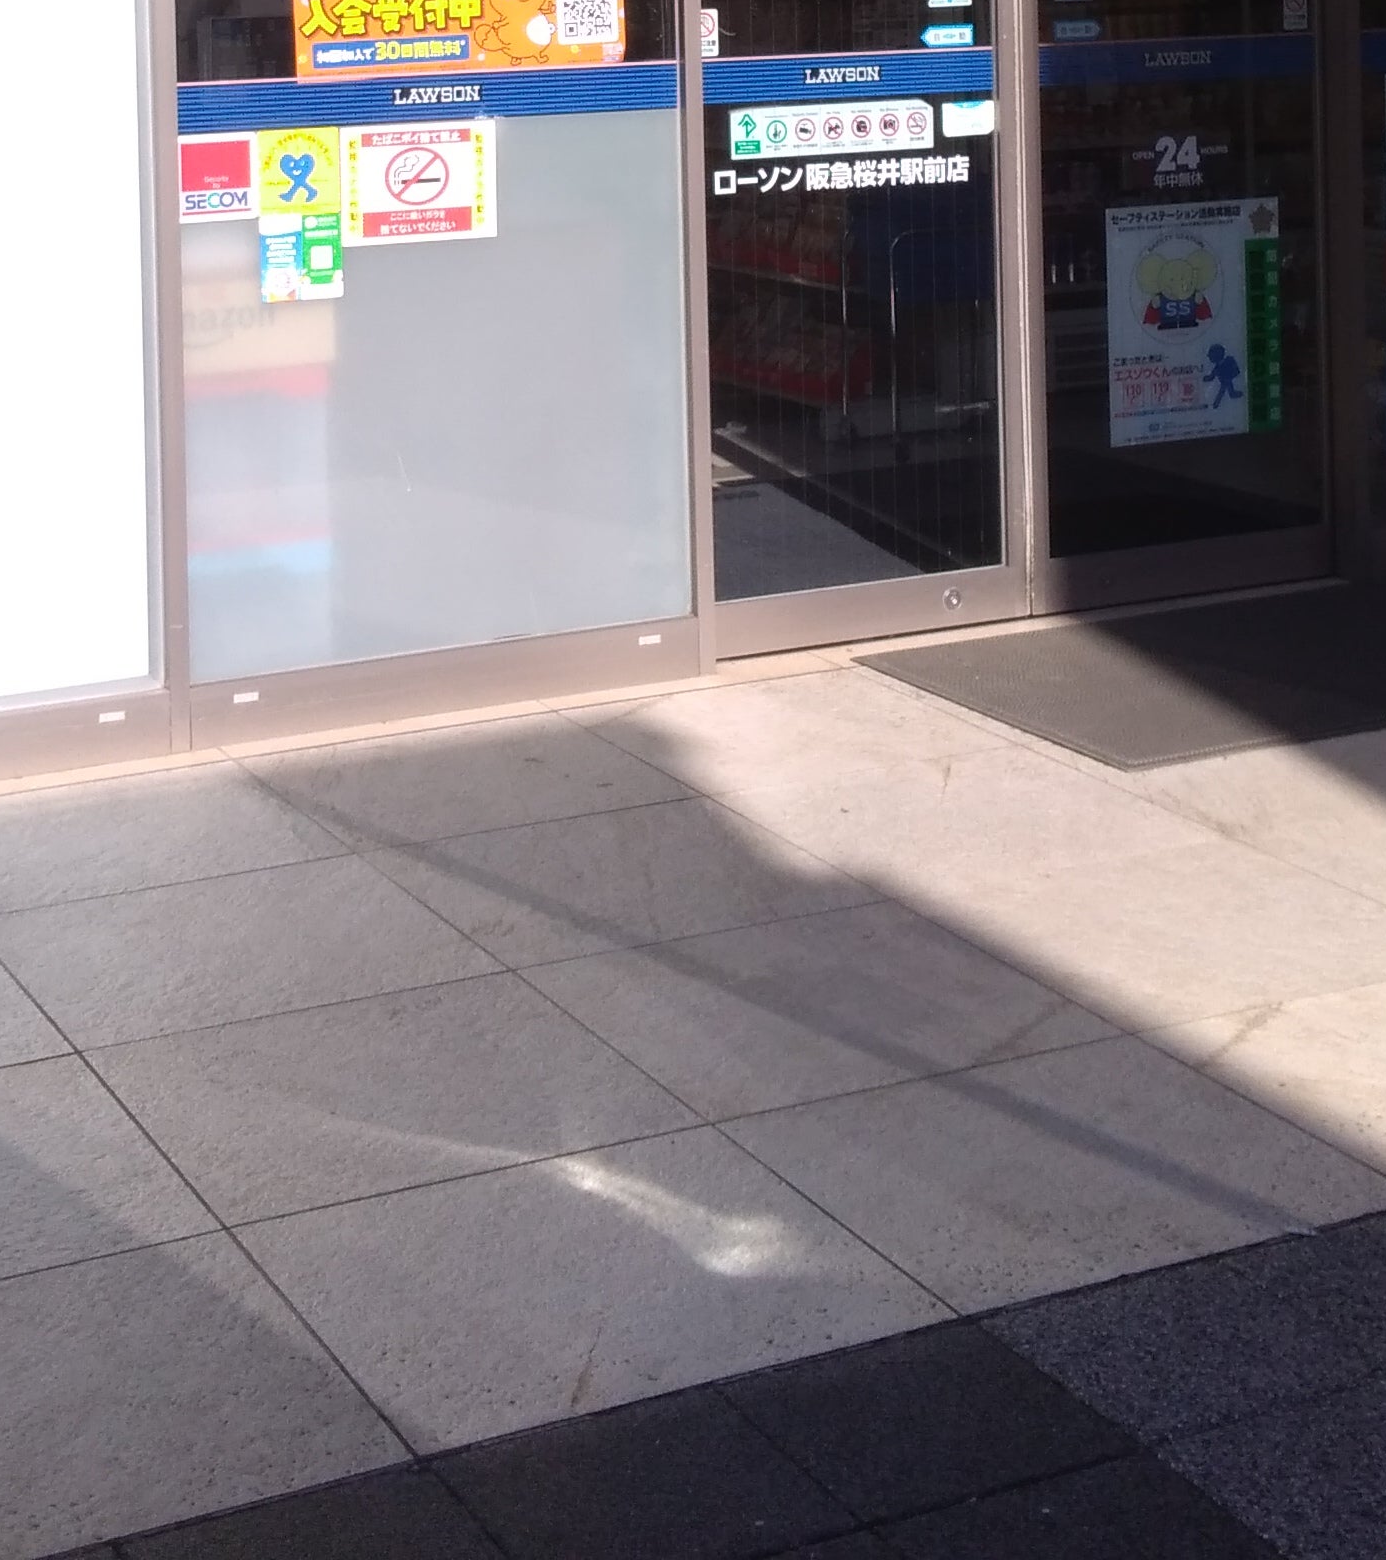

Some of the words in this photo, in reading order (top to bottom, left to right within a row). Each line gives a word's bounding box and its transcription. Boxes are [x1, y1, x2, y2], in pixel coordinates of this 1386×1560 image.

[1143, 50, 1213, 68] LAWSON
[804, 66, 880, 84] LAWSON
[393, 85, 481, 105] LAWSON
[1155, 135, 1201, 173] 24
[185, 191, 248, 211] SECOM
[1163, 300, 1193, 318] SS
